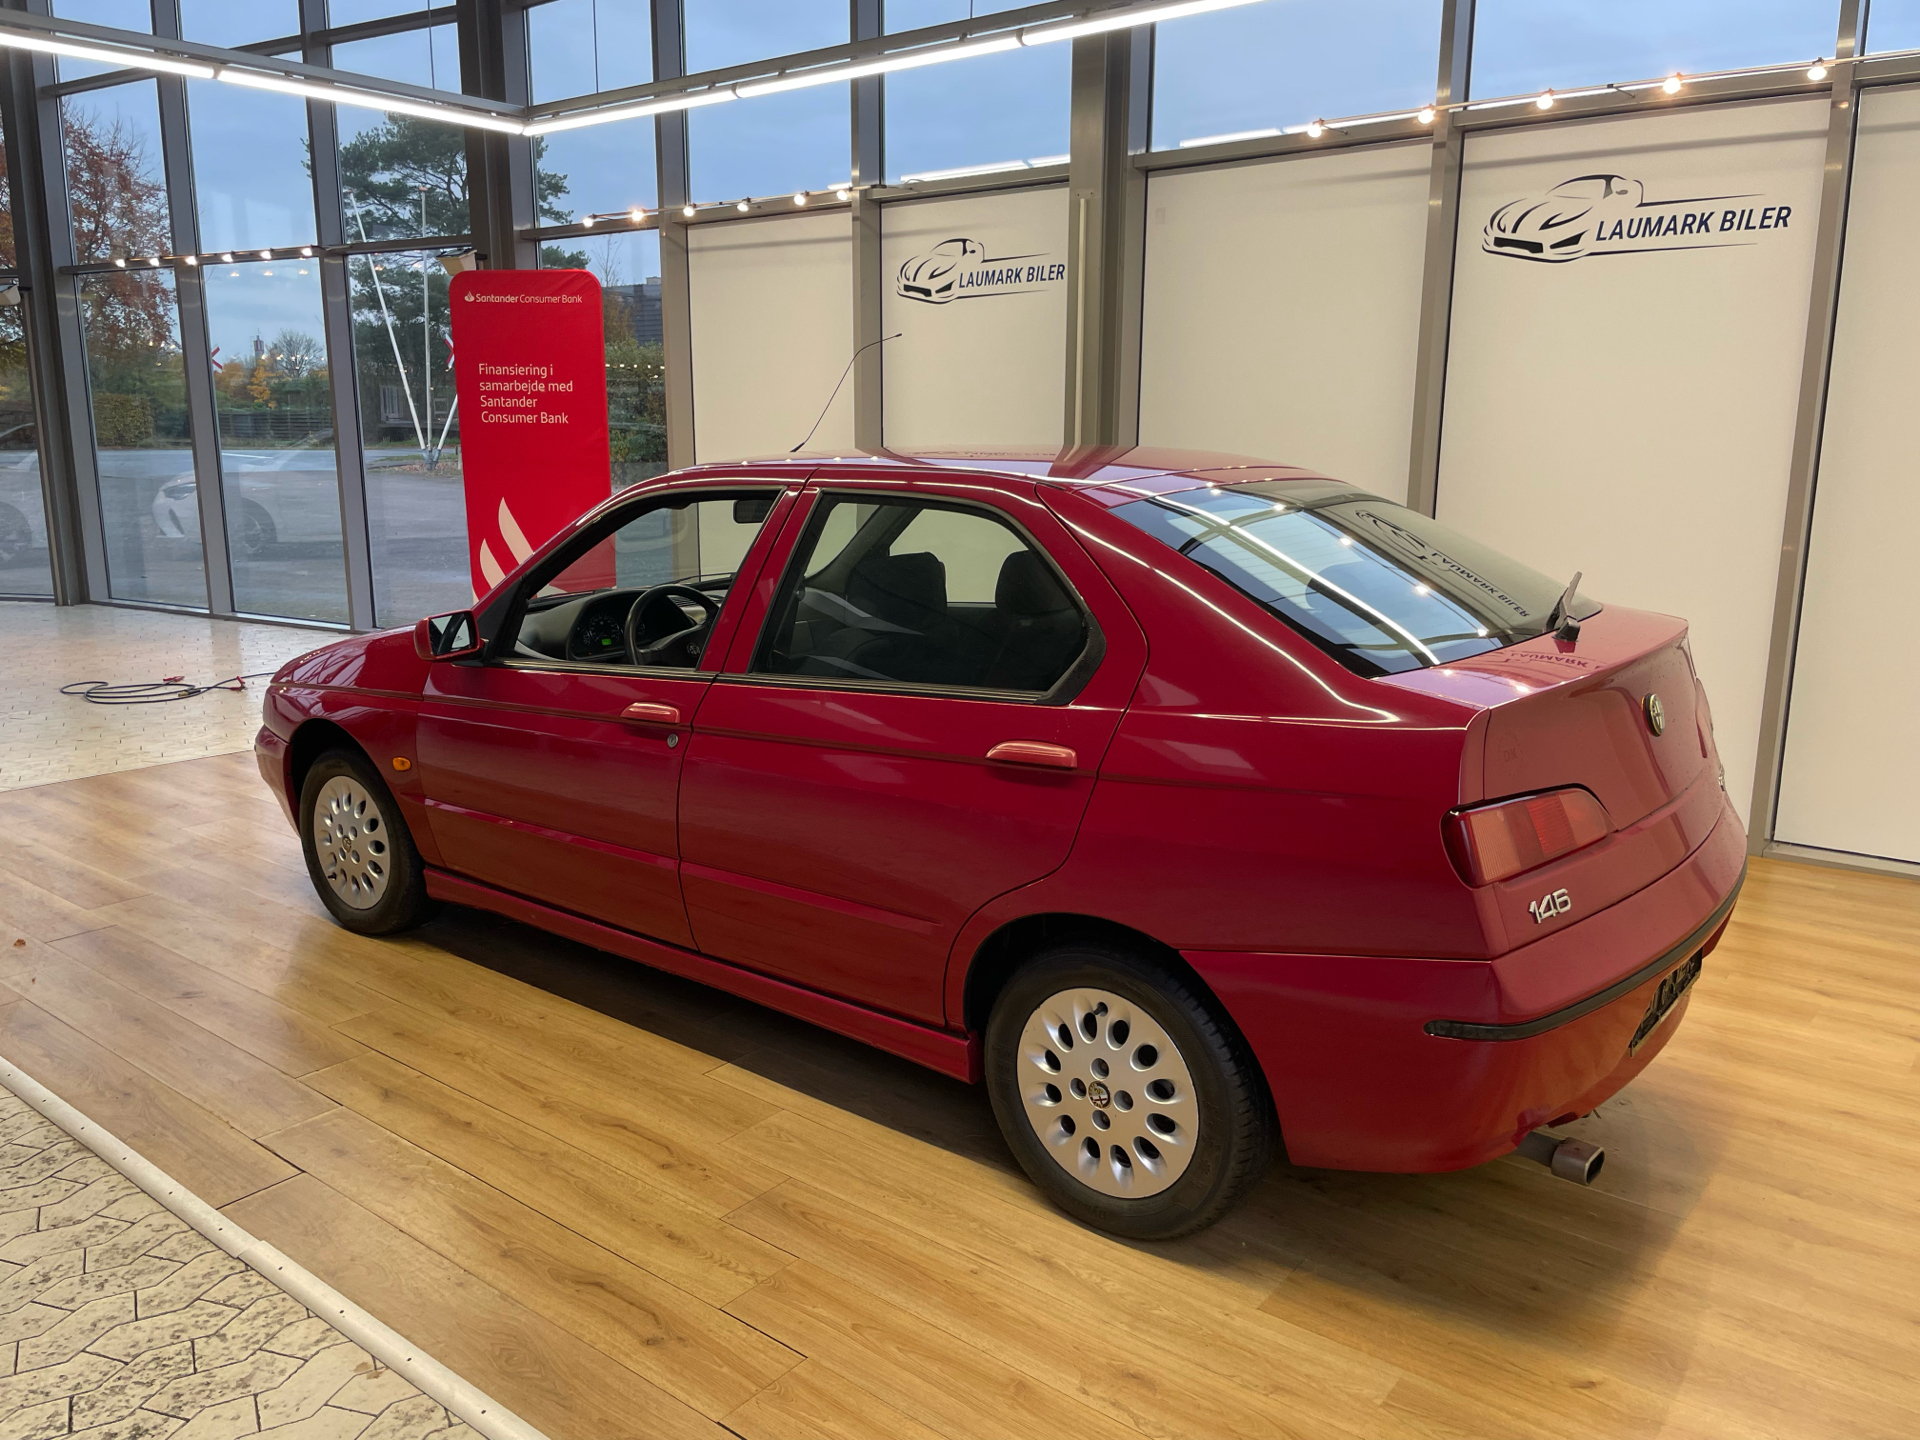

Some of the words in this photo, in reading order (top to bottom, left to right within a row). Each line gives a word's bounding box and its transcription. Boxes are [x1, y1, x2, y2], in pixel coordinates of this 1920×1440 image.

[1595, 210, 1715, 242] LAUMARK
[1718, 205, 1792, 232] BILER
[958, 266, 1024, 289] LAUMARK
[1026, 263, 1066, 283] BILER
[475, 293, 518, 303] Santander
[519, 294, 561, 304] Consumer
[561, 294, 583, 304] Bank
[478, 363, 548, 378] Finansiering
[549, 363, 554, 376] i
[479, 380, 546, 394] samarbejde
[548, 380, 574, 392] med
[480, 395, 538, 408] Santander
[481, 411, 538, 424] Consumer
[540, 411, 569, 425] Bank
[1528, 888, 1571, 924] 146
